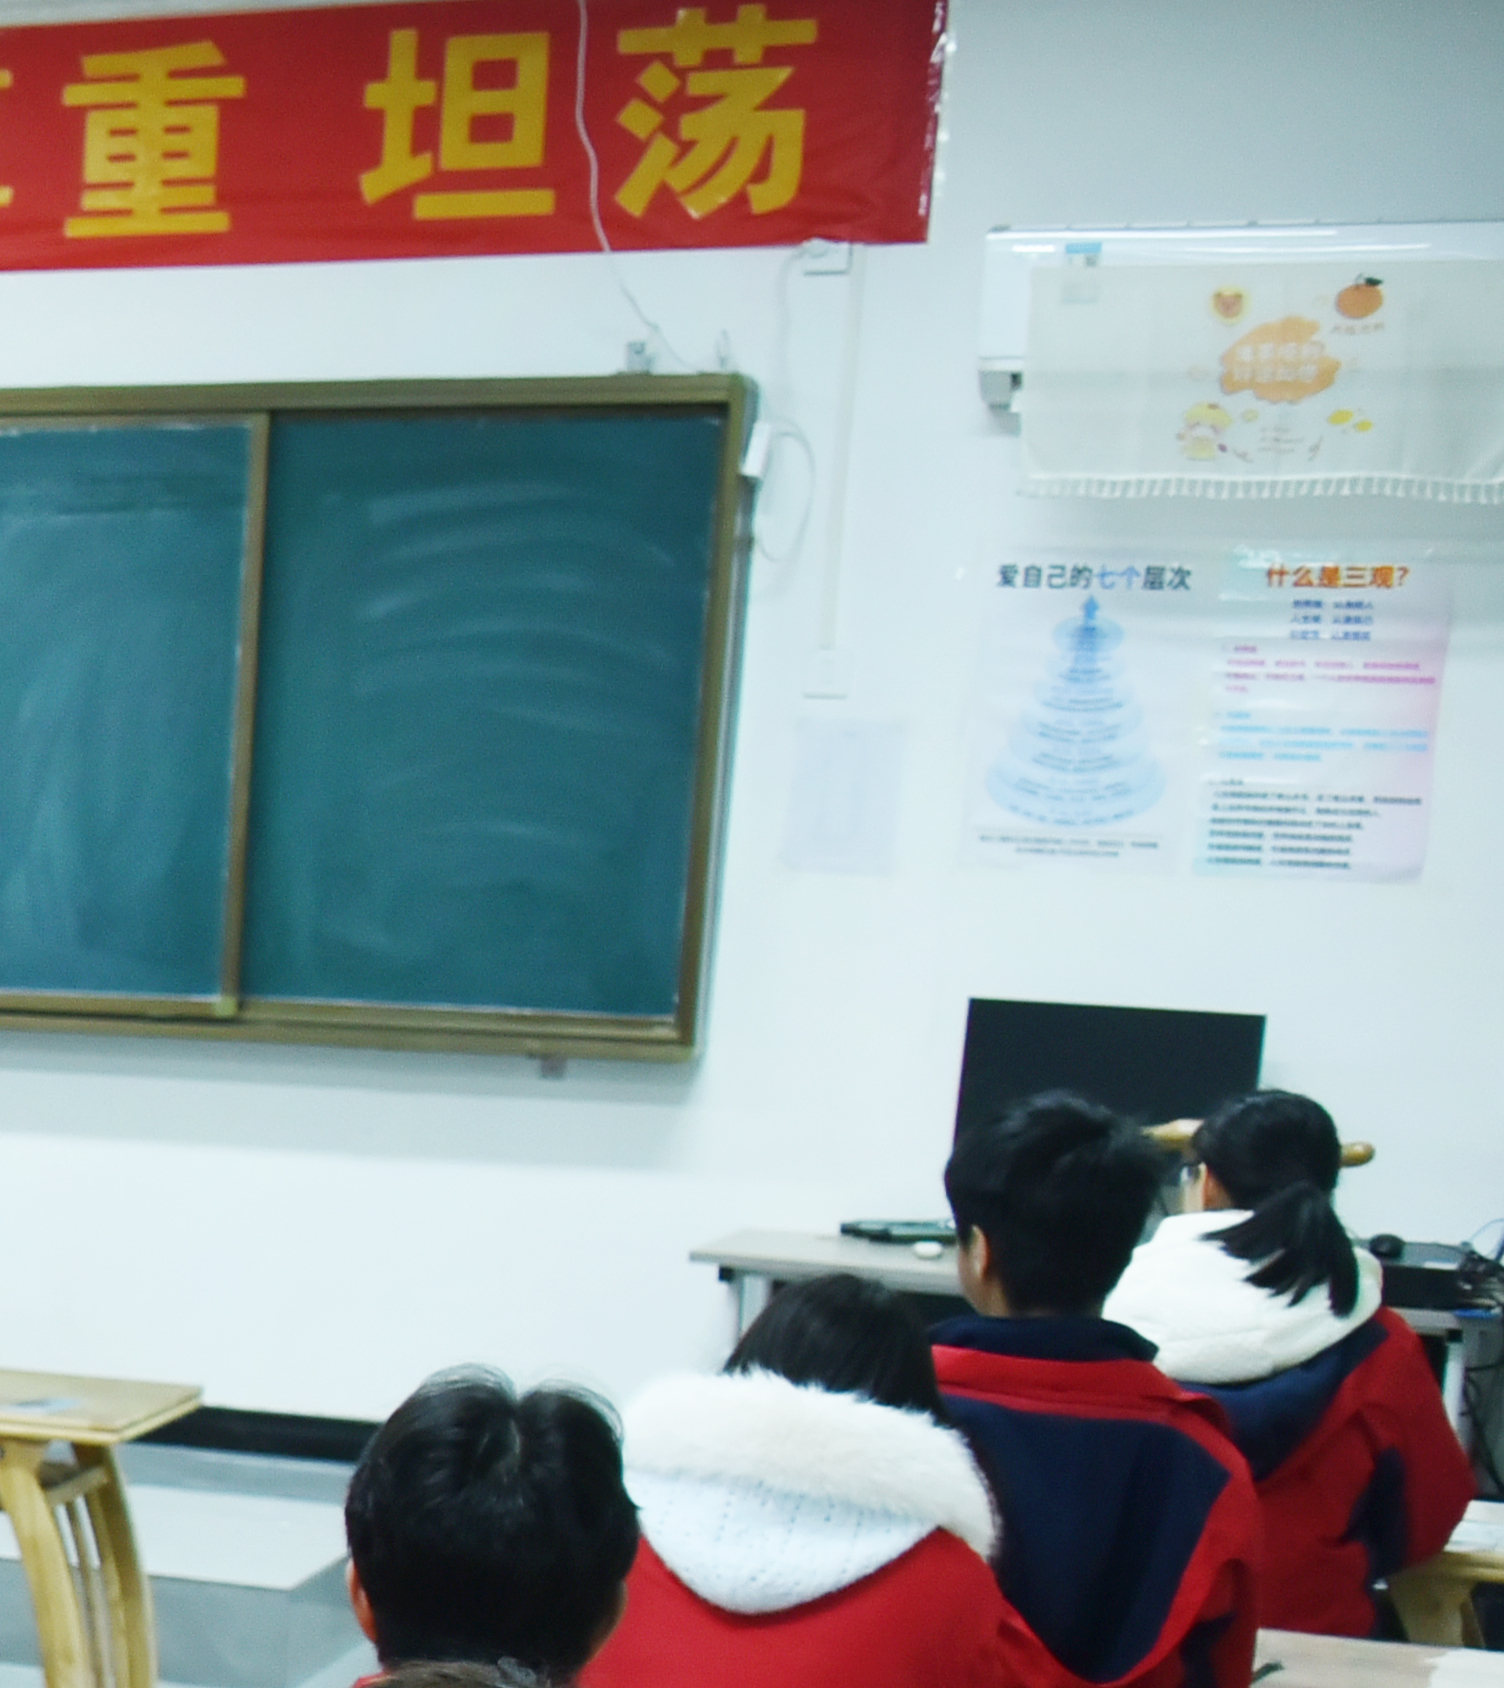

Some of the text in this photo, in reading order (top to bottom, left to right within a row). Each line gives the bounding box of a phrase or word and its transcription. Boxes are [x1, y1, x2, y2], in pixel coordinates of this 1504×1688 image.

[360, 5, 819, 220] 坦荡
[996, 562, 1193, 591] 爱自己的七个层次
